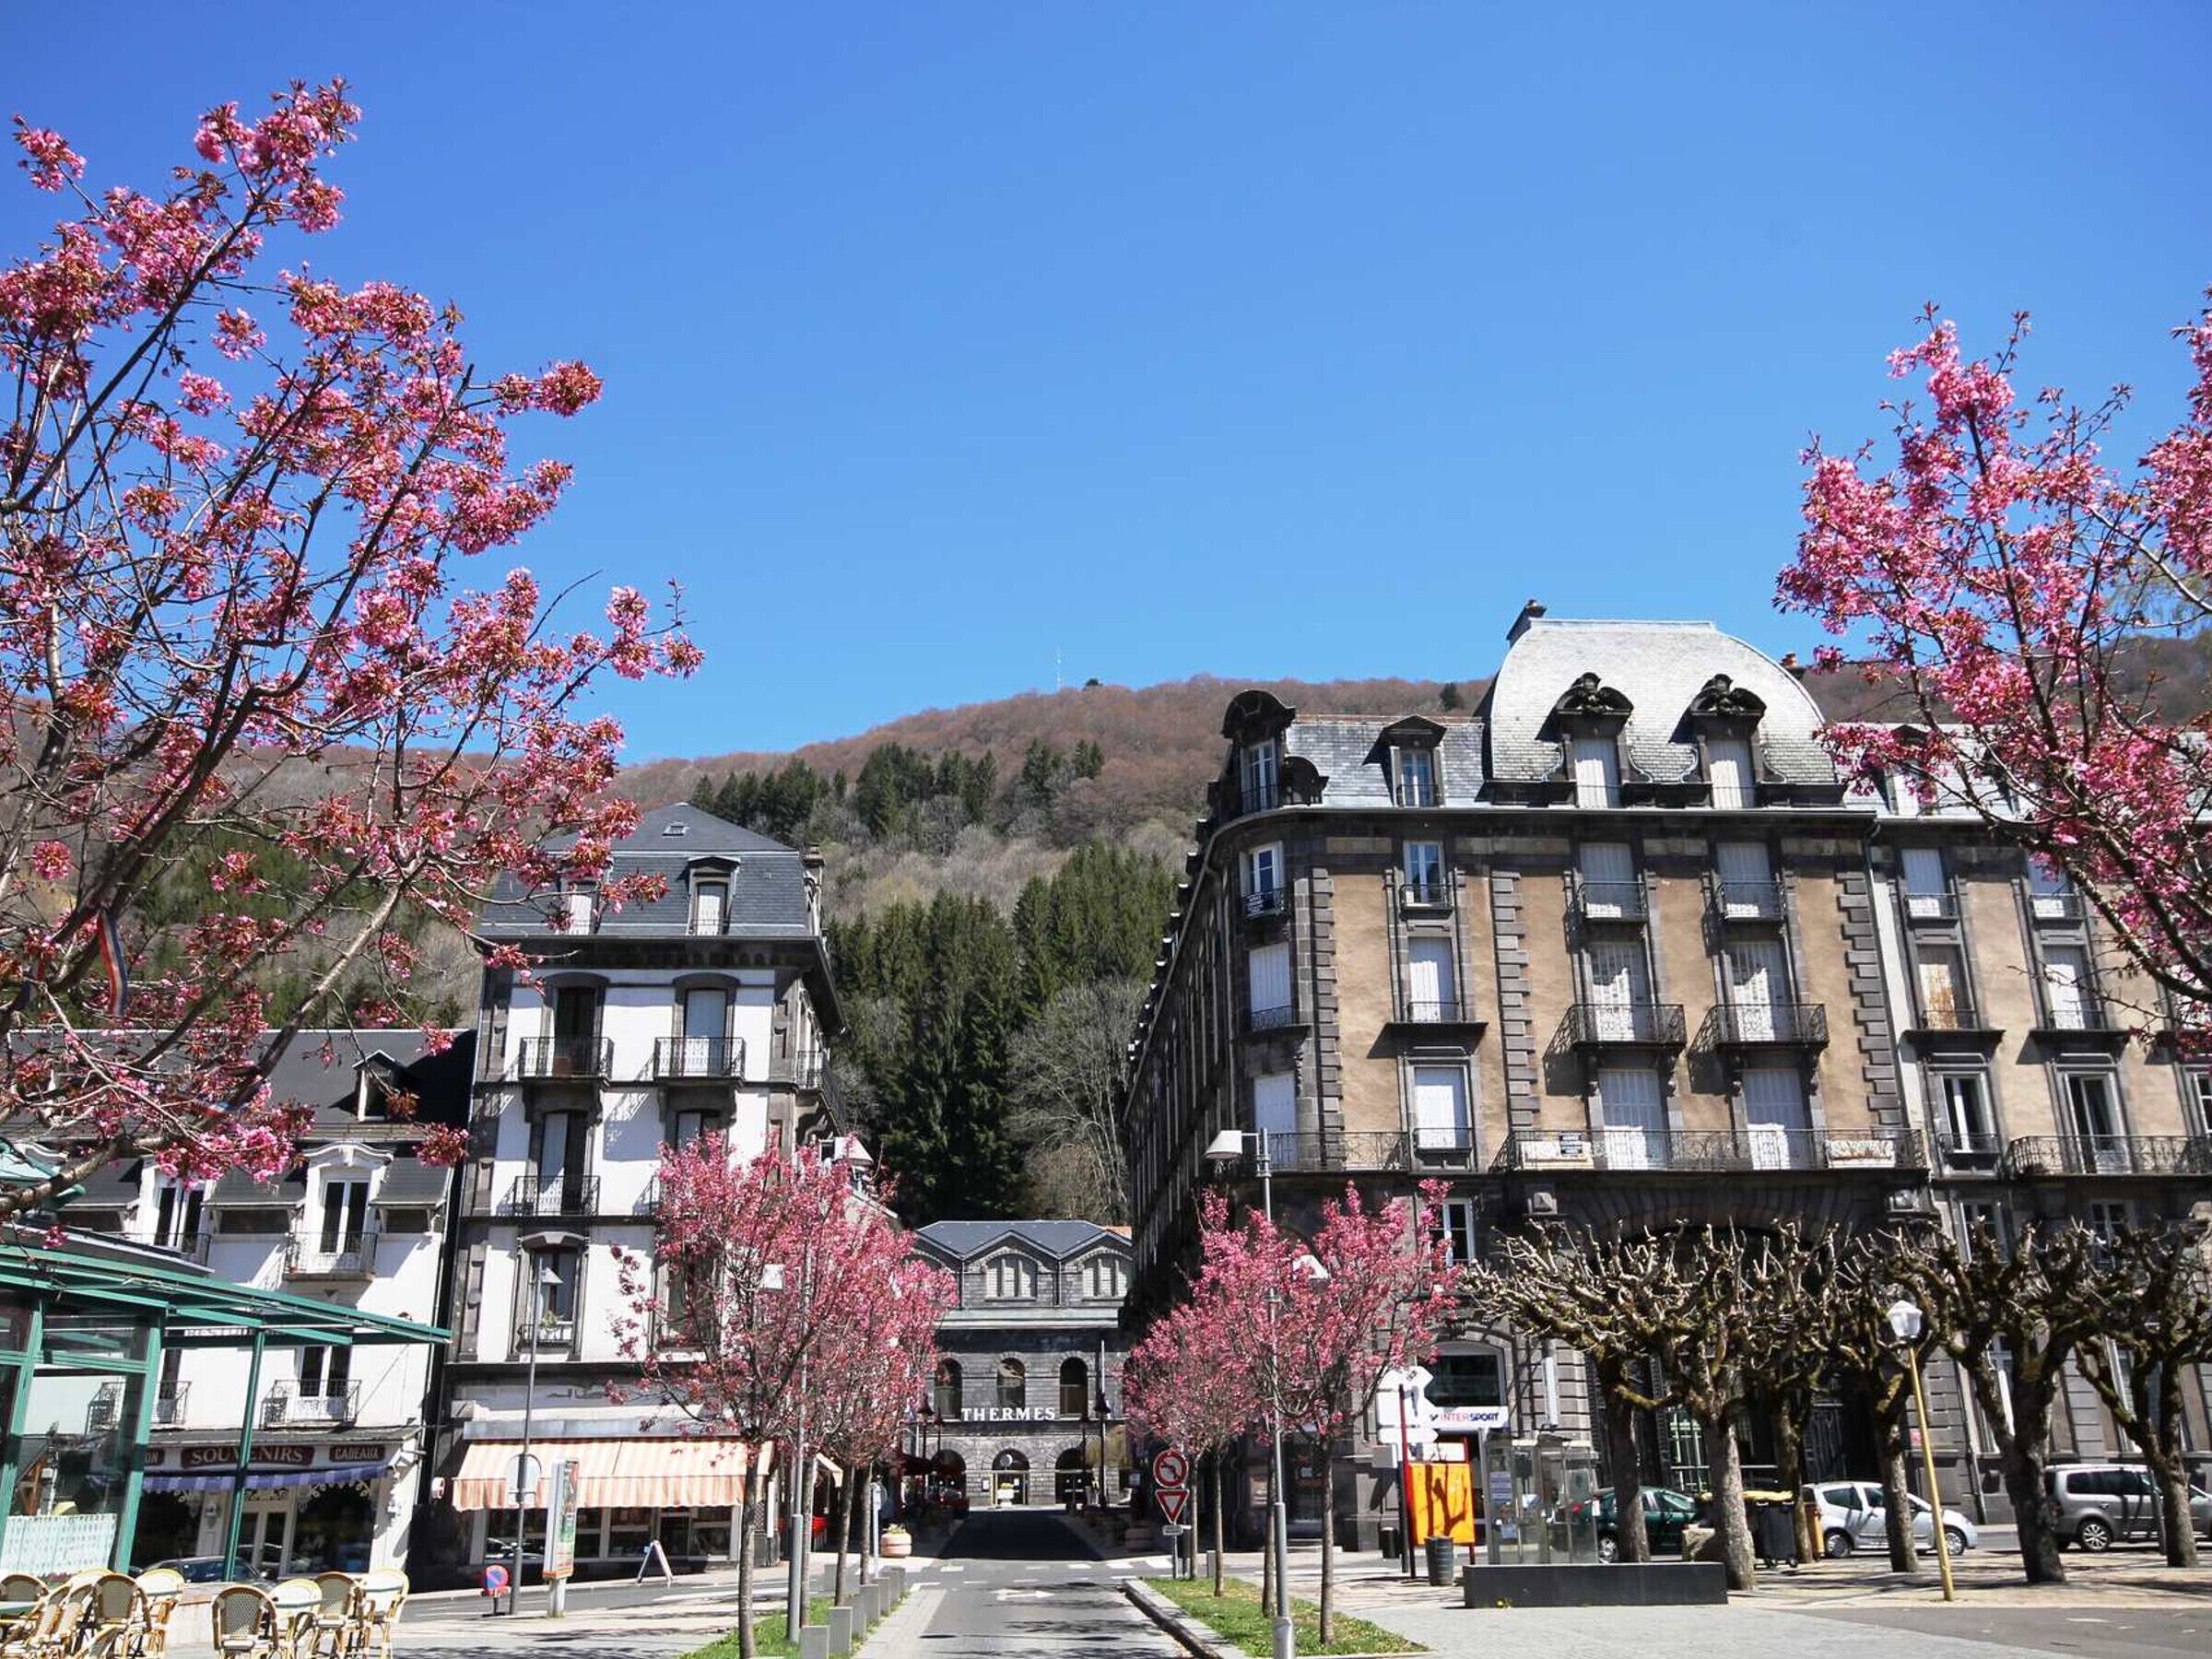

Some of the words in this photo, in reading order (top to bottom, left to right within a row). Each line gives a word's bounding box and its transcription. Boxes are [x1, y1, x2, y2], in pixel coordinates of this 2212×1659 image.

[960, 1406, 1055, 1421] THERMES
[1440, 1412, 1499, 1422] INTERSPORT
[335, 1447, 379, 1461] CADEAUX
